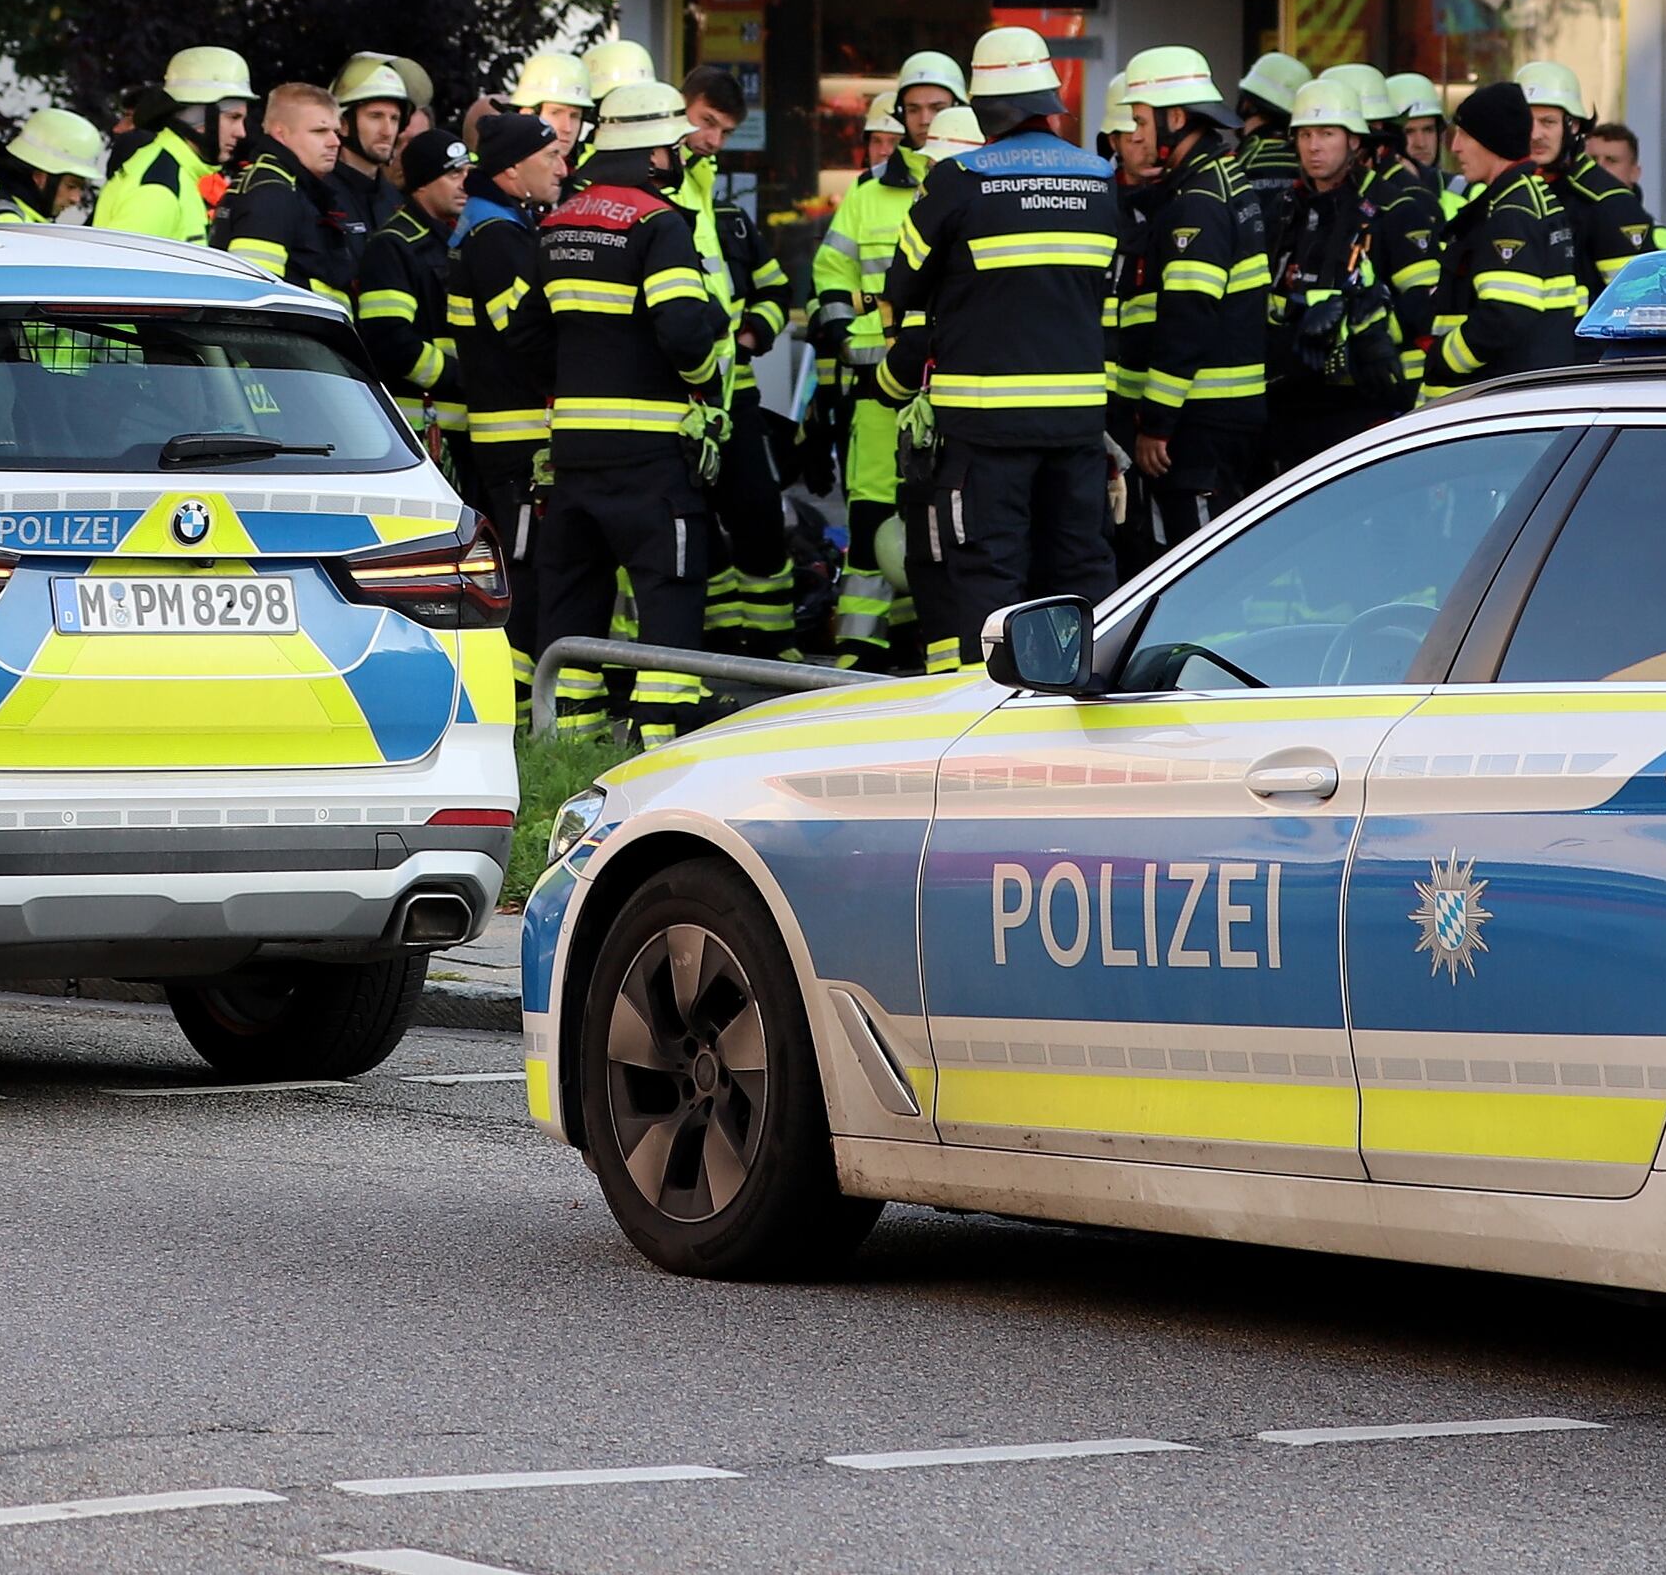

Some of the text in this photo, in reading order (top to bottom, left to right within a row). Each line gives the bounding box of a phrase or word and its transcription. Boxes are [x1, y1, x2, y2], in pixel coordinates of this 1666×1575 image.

[1021, 194, 1087, 210] MÜNCHEN
[79, 583, 290, 626] M PM 8298
[993, 862, 1282, 970] POLIZEI
